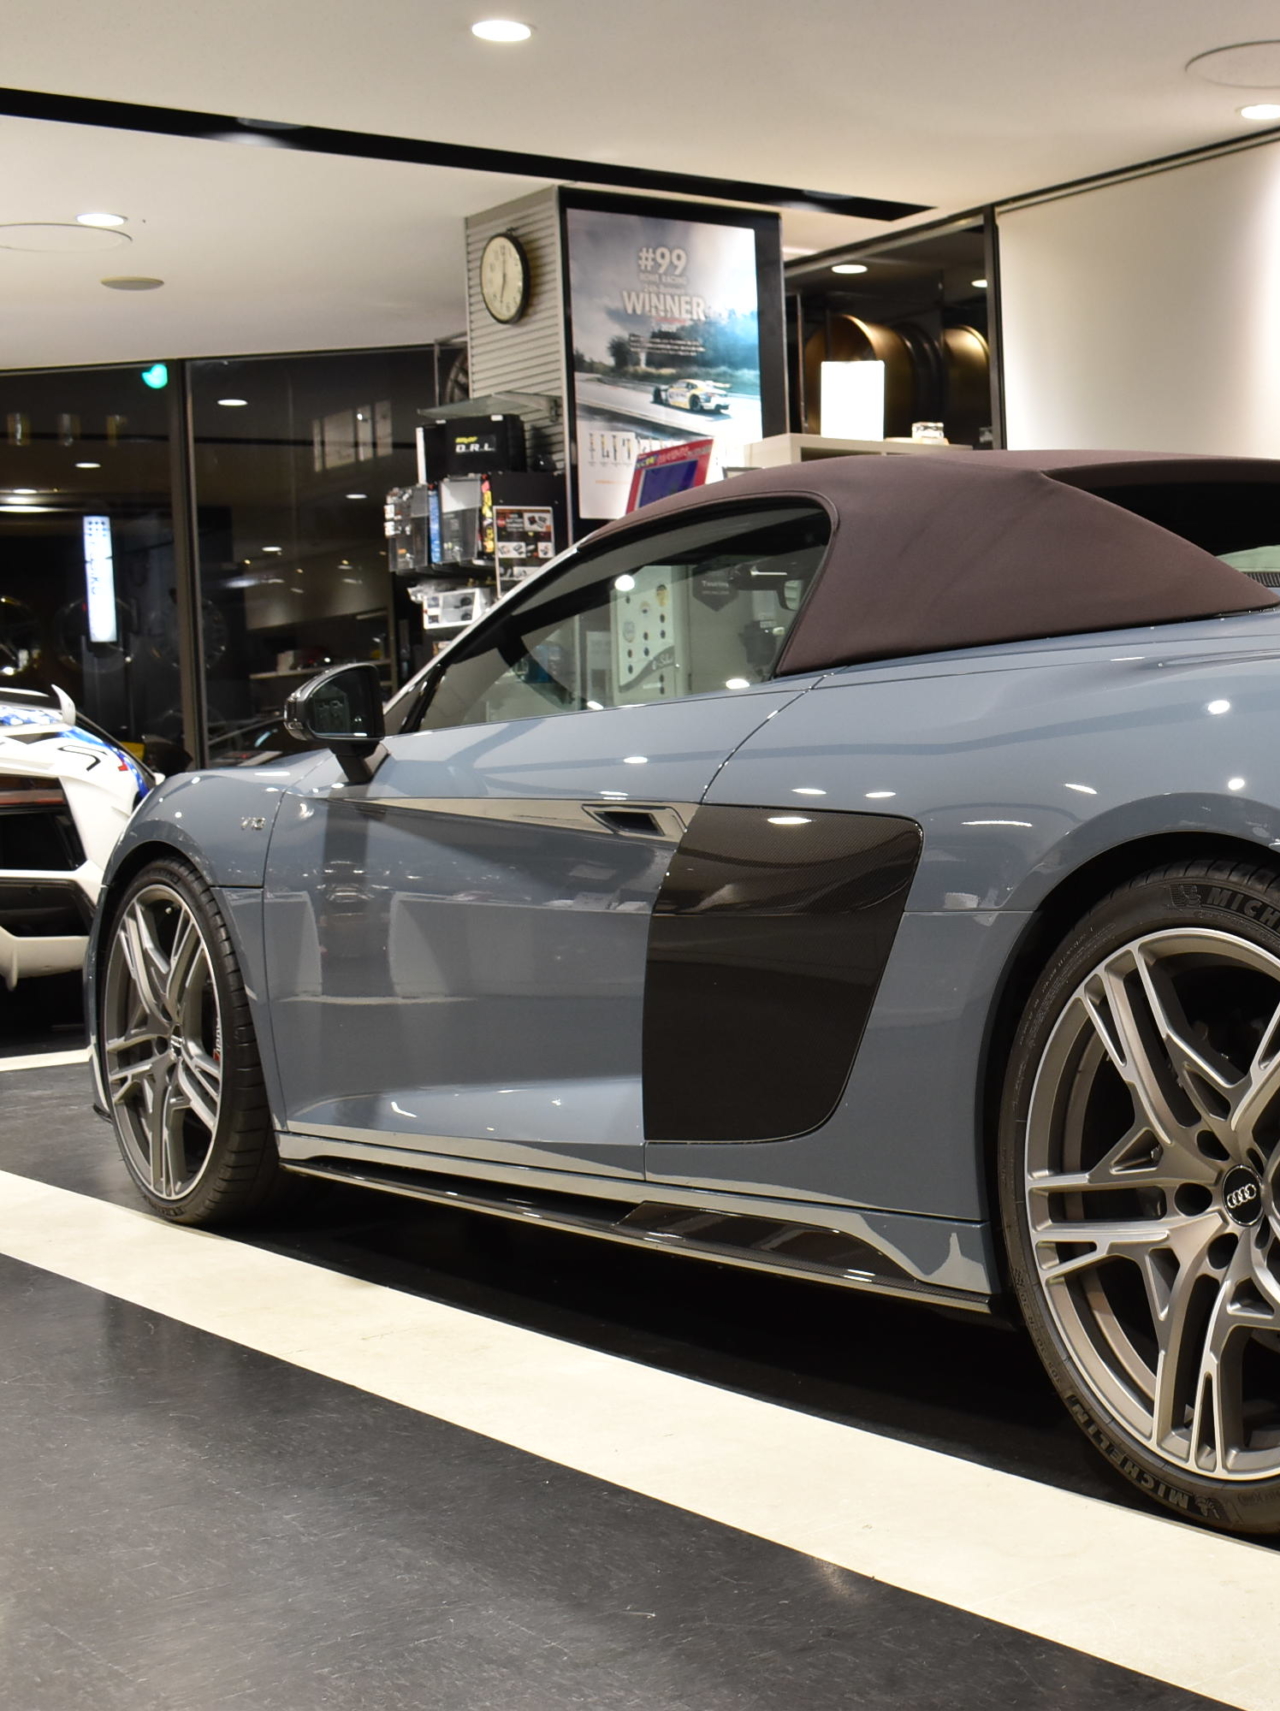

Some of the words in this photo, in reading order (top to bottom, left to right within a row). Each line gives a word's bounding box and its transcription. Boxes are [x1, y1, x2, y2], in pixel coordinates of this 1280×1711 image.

[639, 246, 688, 275] #99
[622, 290, 706, 321] WINNER
[1071, 1403, 1190, 1509] MICHELIN
